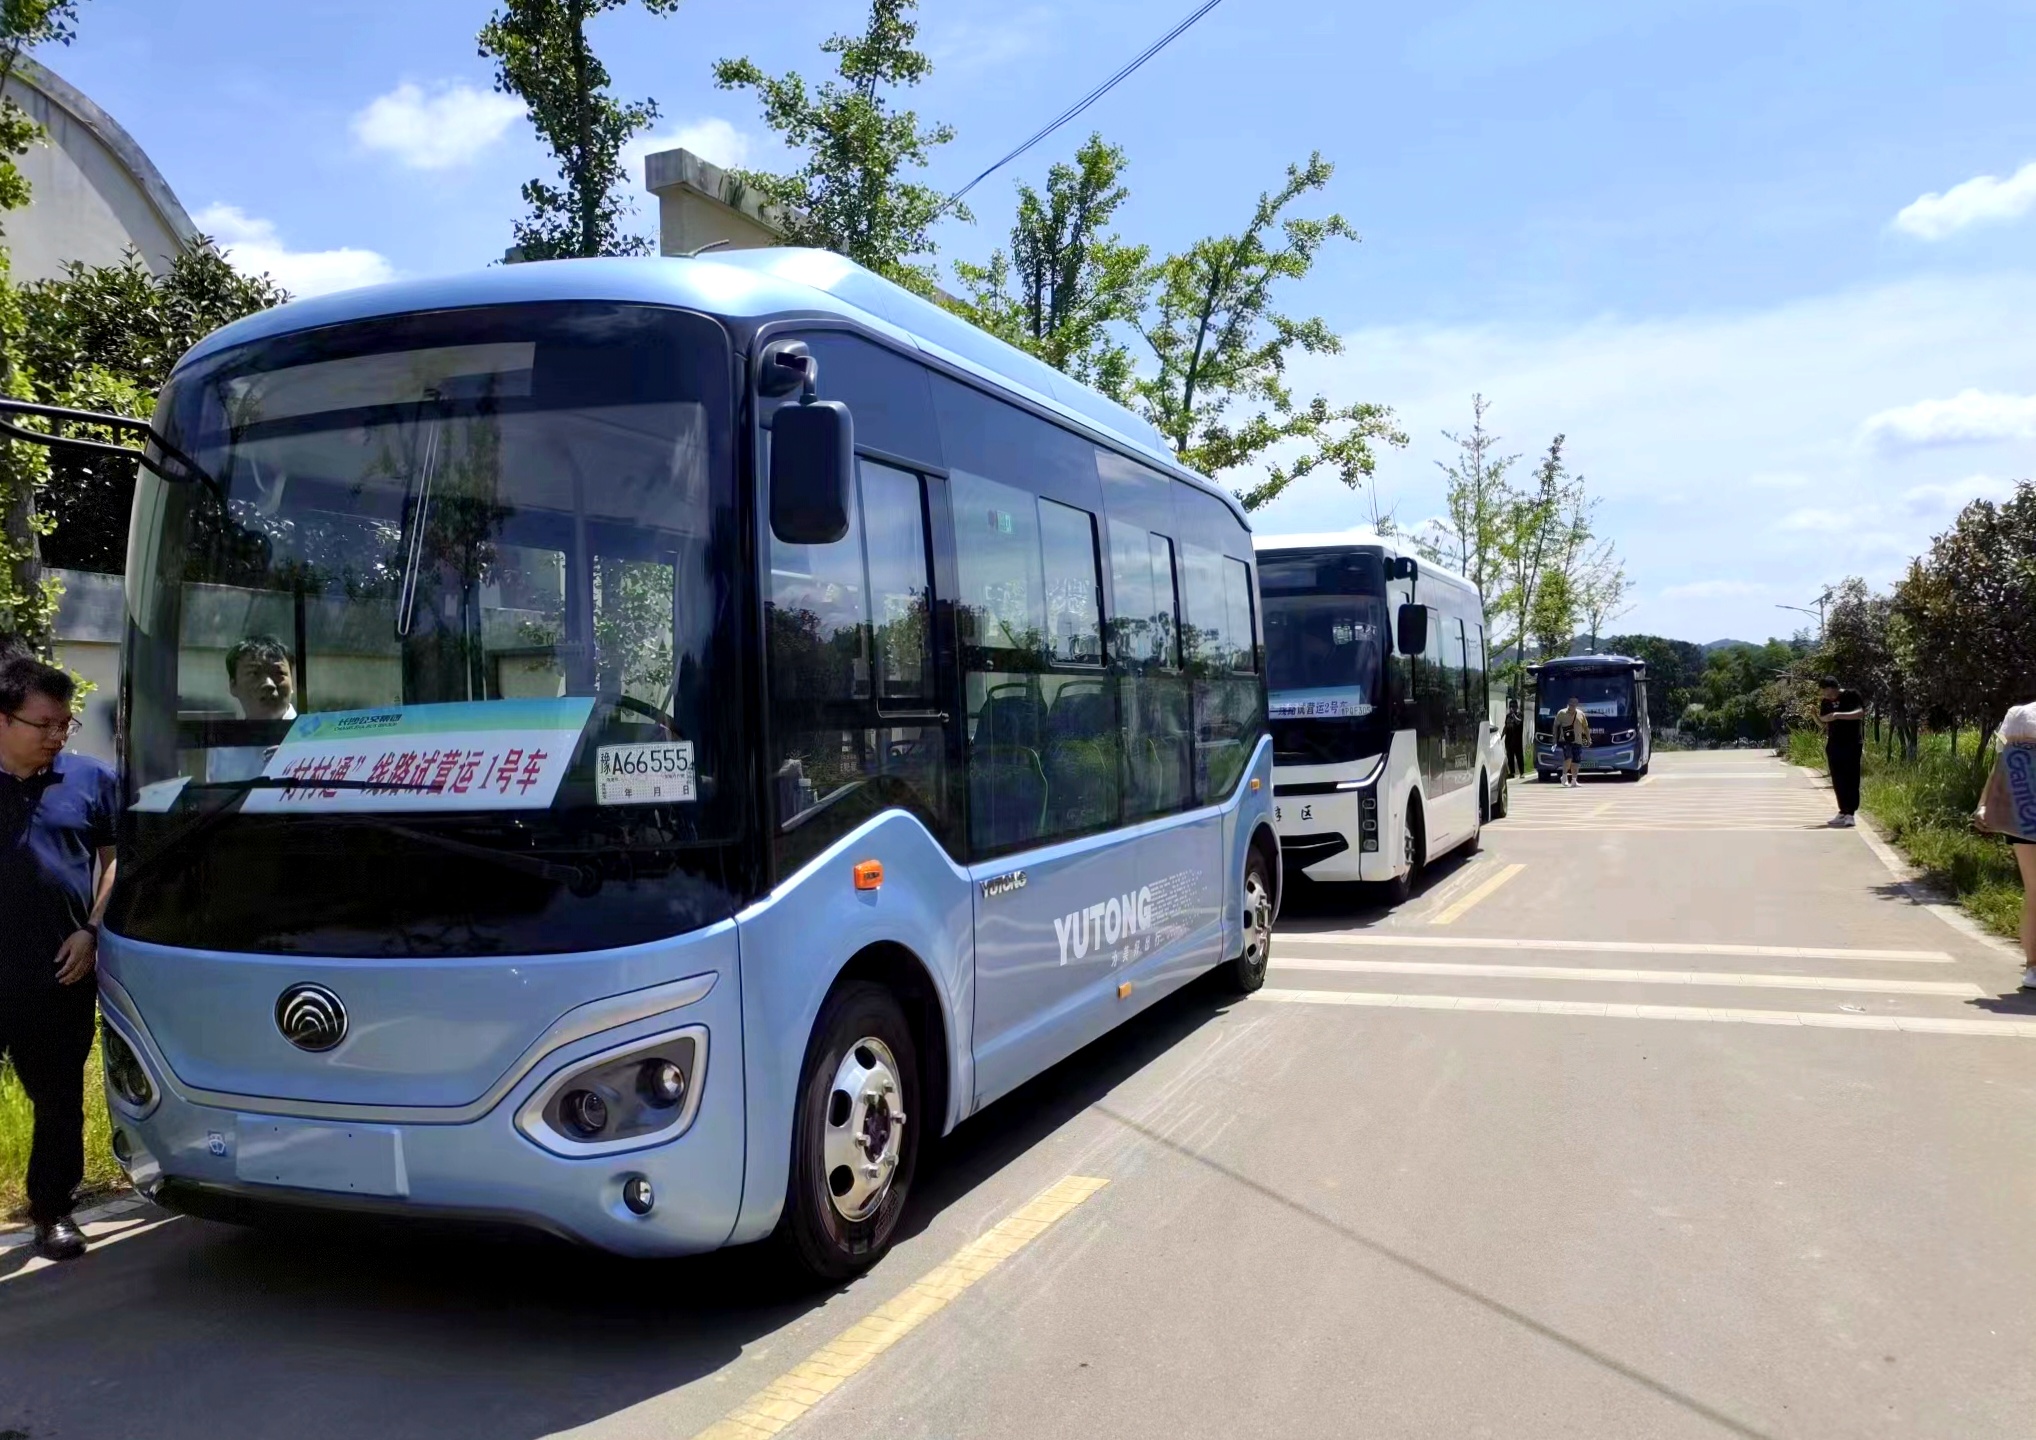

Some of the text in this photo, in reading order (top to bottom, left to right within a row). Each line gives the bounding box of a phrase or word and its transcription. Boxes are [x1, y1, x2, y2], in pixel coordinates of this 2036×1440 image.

[601, 748, 688, 775] 豫A66555
[979, 870, 1028, 898] YUTONG
[1053, 886, 1151, 966] YUTONG
[1110, 930, 1162, 968] 为美好出行
